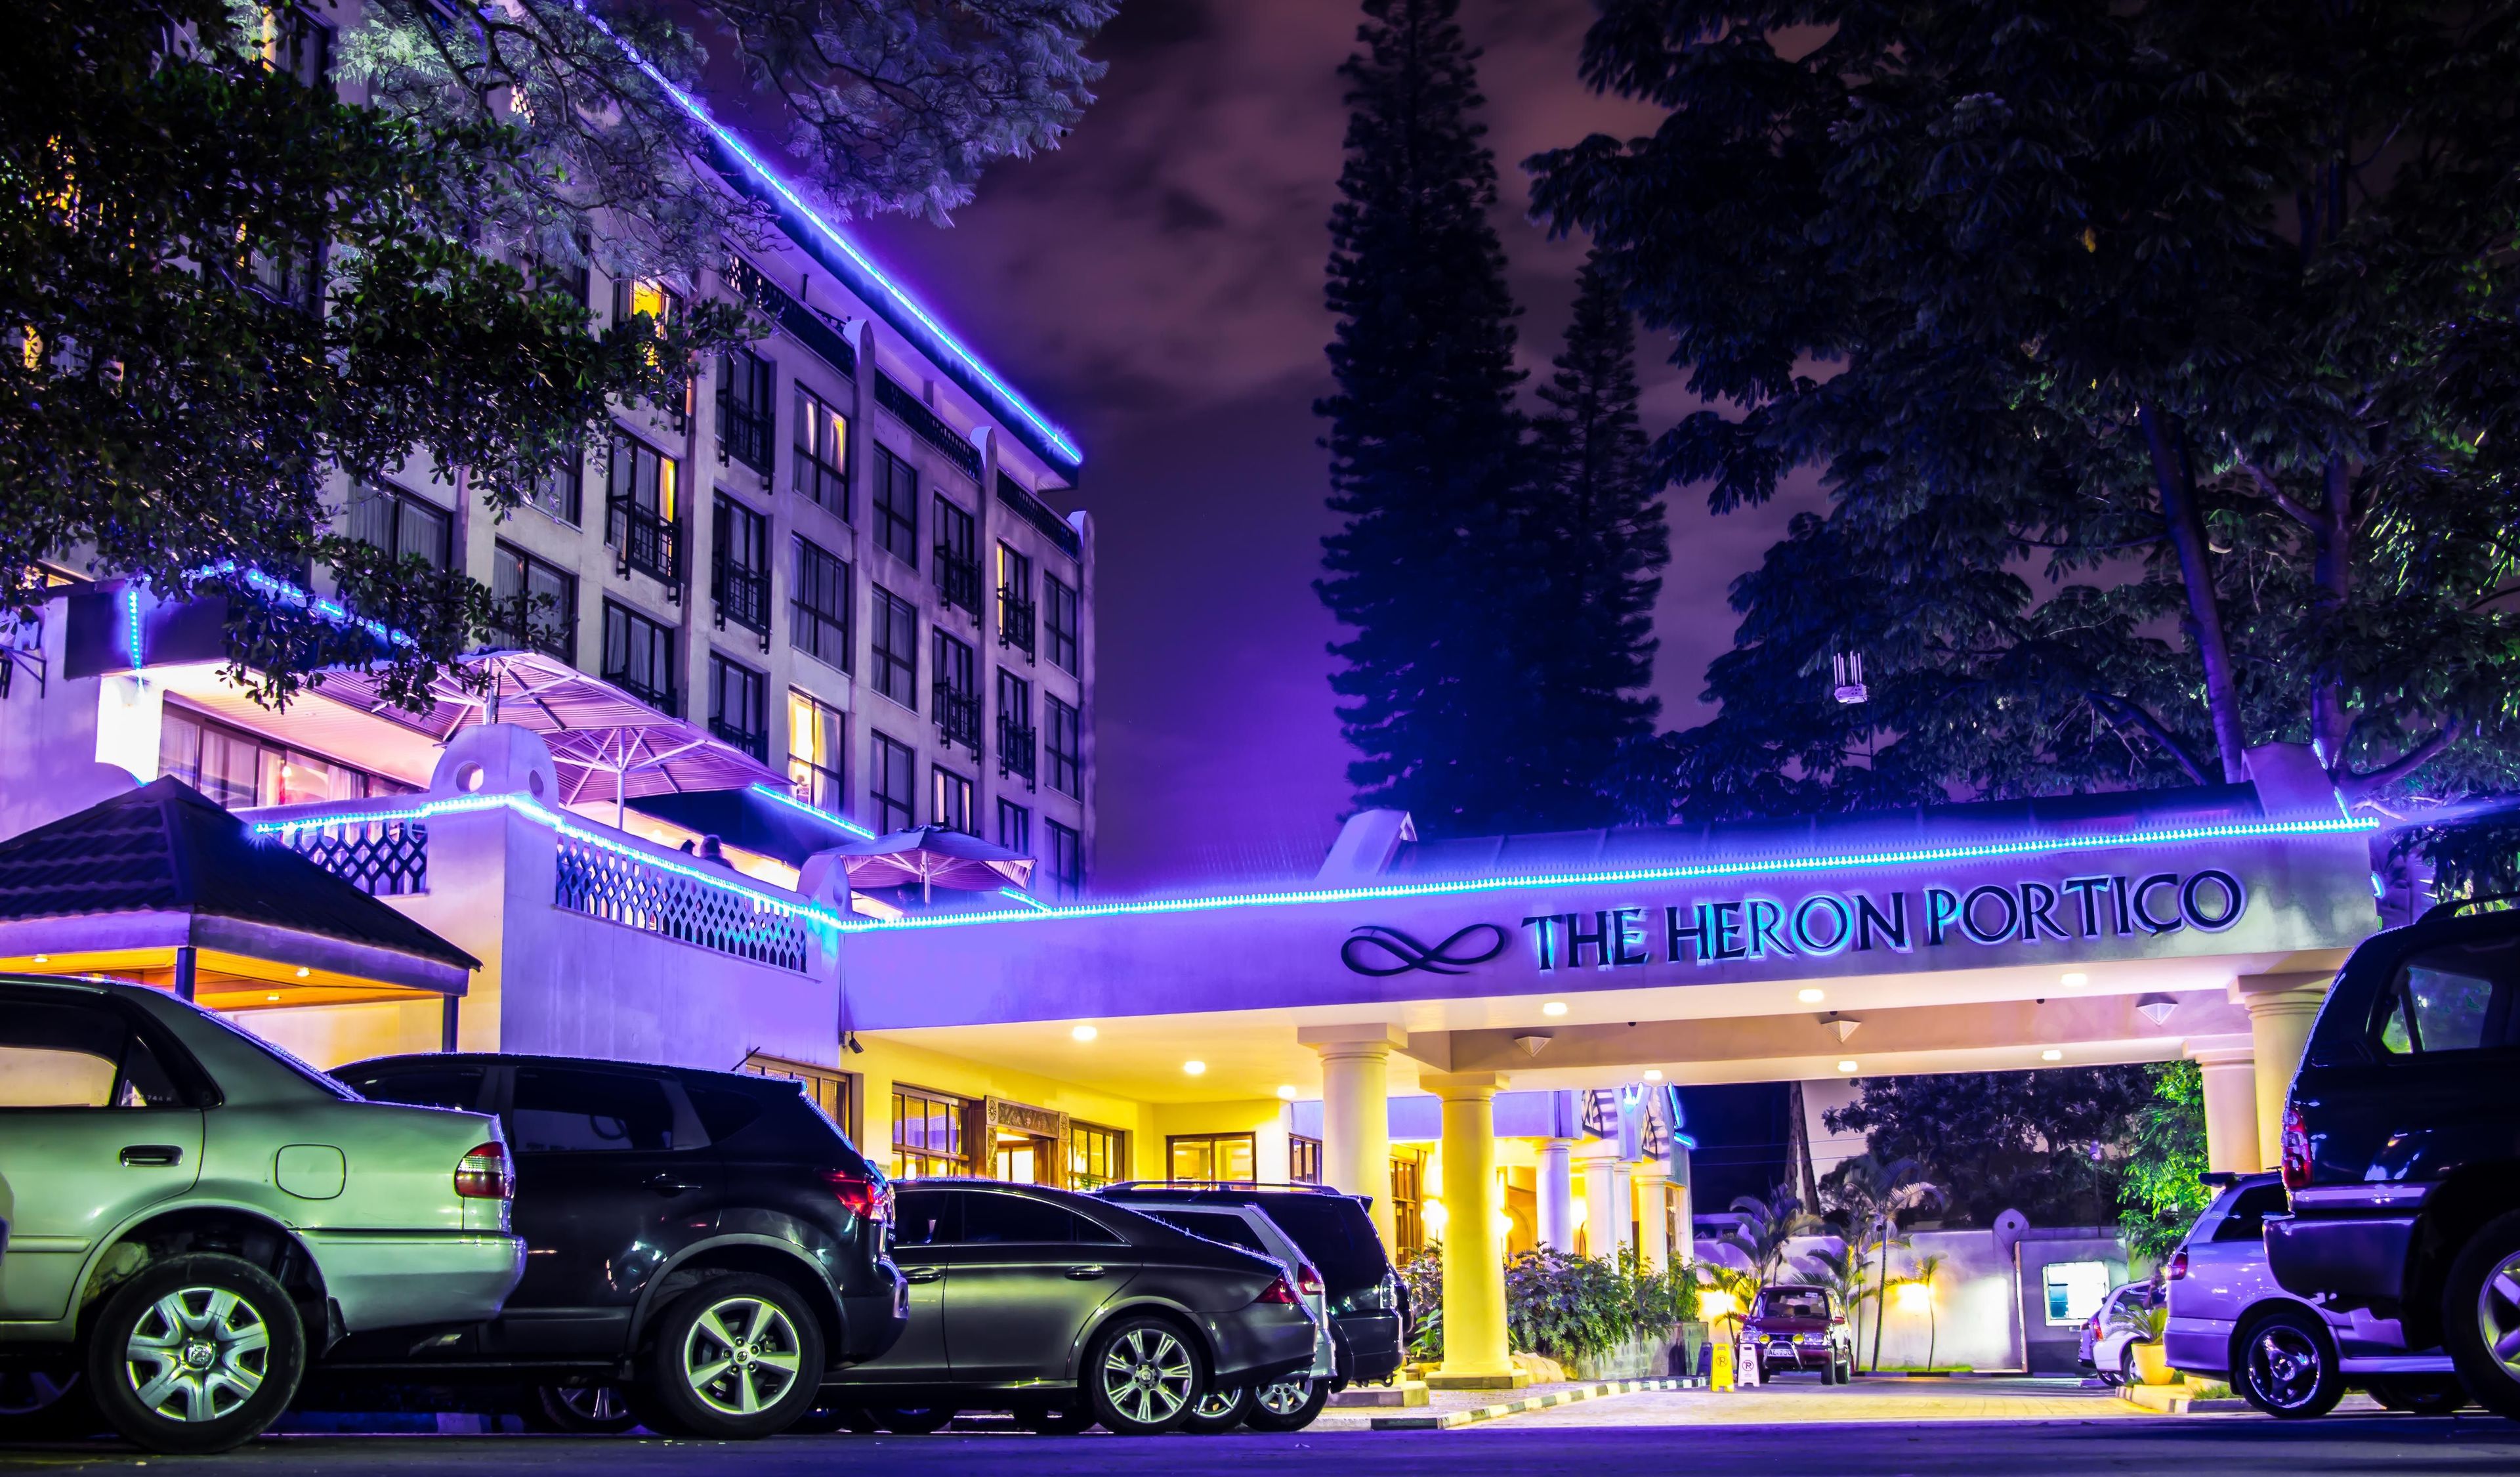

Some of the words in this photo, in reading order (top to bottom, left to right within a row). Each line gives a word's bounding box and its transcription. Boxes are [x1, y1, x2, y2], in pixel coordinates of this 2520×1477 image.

[1521, 907, 1647, 970] THE
[1664, 891, 1908, 965] HERON
[1925, 868, 2243, 947] PORTICO
